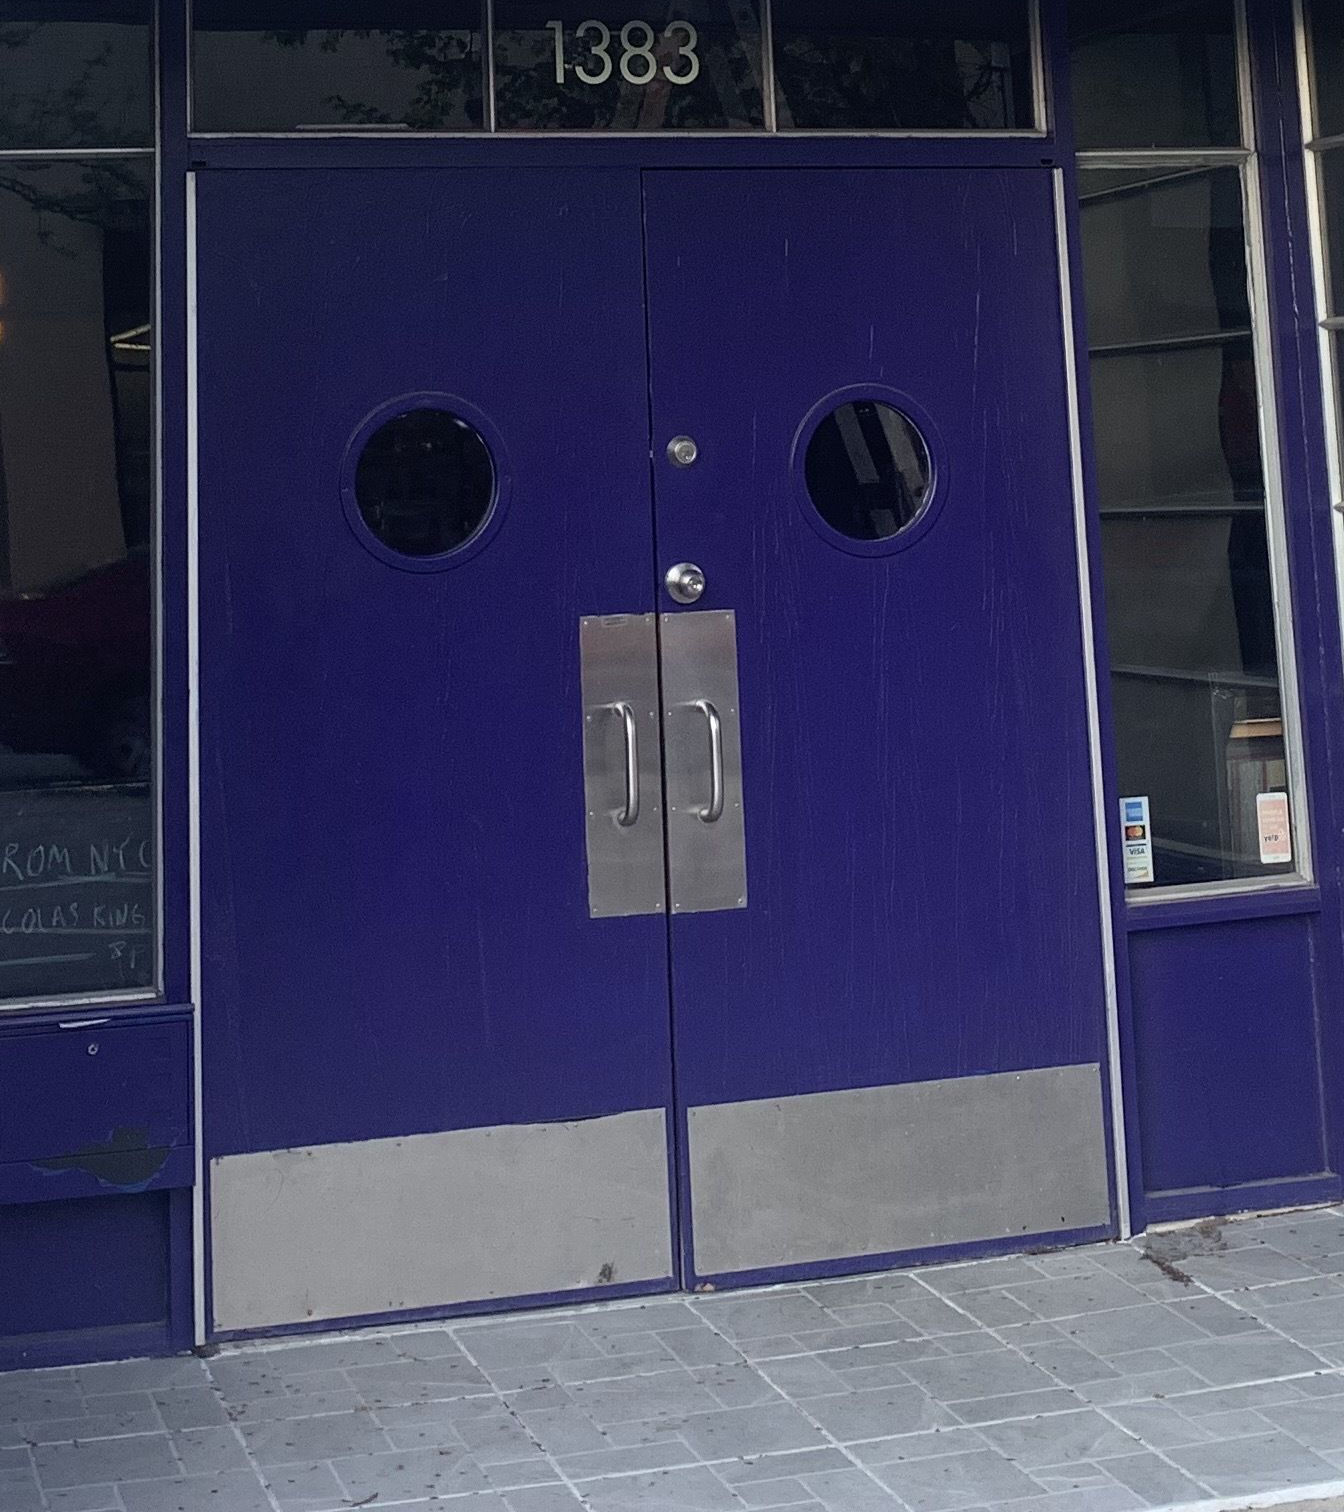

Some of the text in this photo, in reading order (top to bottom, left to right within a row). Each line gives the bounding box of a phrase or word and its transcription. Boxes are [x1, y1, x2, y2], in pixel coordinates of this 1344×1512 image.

[544, 19, 701, 86] 1383
[1128, 848, 1146, 856] VISA
[92, 902, 146, 928] KING
